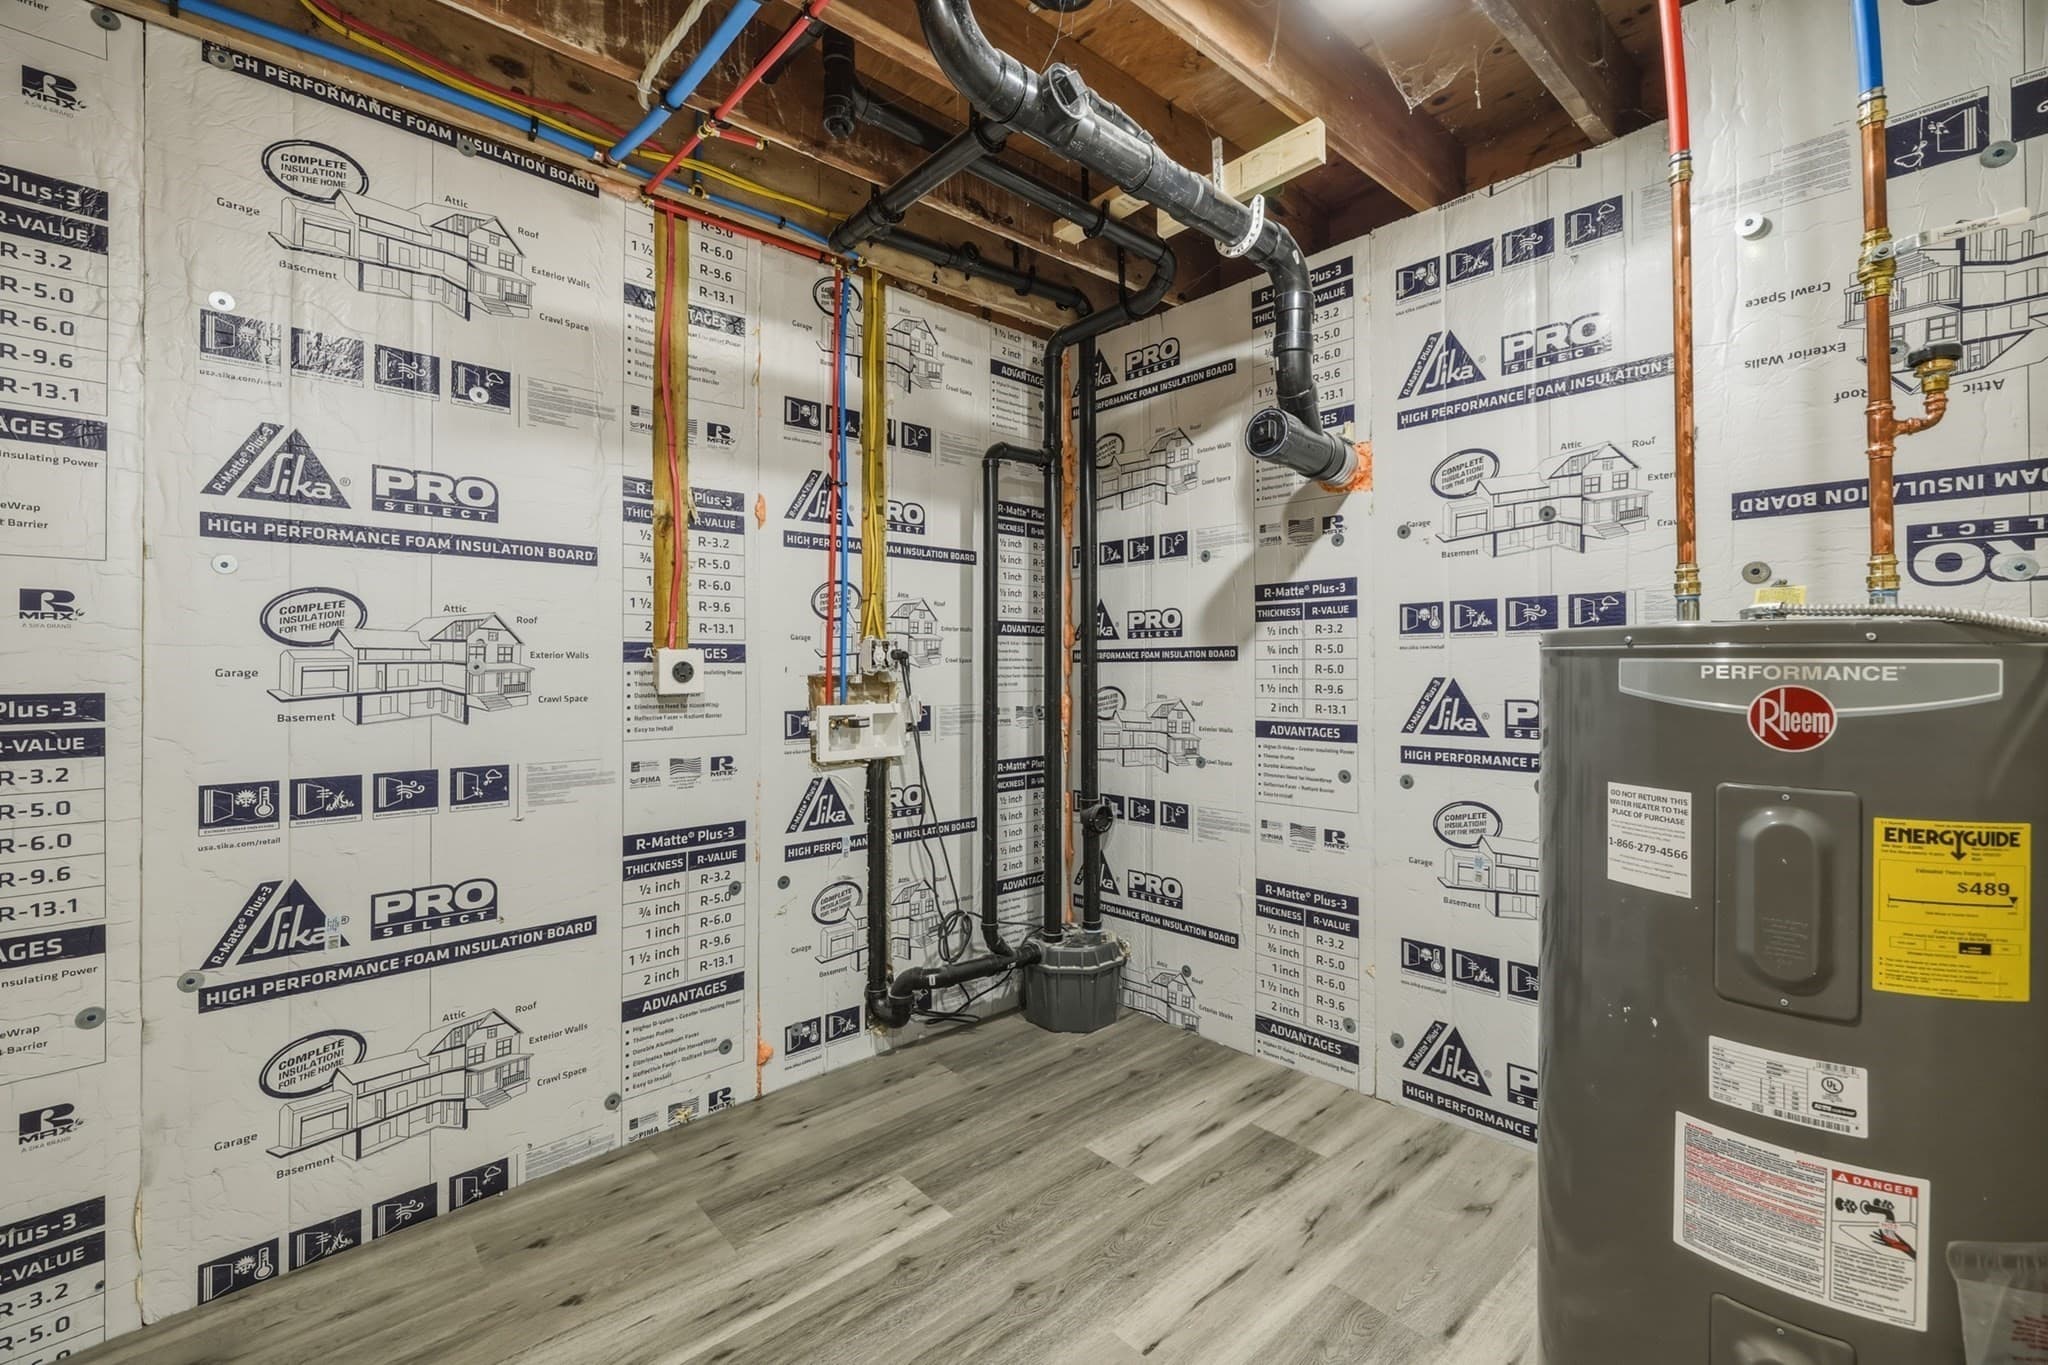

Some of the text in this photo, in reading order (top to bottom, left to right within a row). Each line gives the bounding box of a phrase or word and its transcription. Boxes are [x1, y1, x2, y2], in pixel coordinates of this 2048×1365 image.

[265, 58, 595, 192] PERFORMANCE FOAM BOARD
[280, 153, 347, 171] COMPLETE
[280, 163, 347, 179] INSULATION!
[280, 173, 346, 188] FOR THE HOME
[216, 196, 261, 217] Garage
[444, 194, 469, 209] Attic
[517, 227, 540, 240] Roof
[0, 242, 72, 270] R-3.2
[700, 241, 733, 261] R-6.0
[279, 259, 337, 281] Basement
[531, 265, 591, 290] Exterior Walls
[700, 263, 732, 283] R-9.6
[0, 275, 74, 304] R-5.0
[699, 286, 734, 305] R-13.1
[1745, 281, 1831, 308] Crawl Space
[0, 309, 74, 336] R-6.0
[539, 312, 590, 333] Crawl Space
[1503, 314, 1611, 361] PRO
[0, 342, 73, 368] R-9.6
[1127, 340, 1179, 371] PRO
[1744, 342, 1847, 369] Exterior Walls
[1129, 360, 1178, 380] SELECT
[1160, 363, 1233, 391] INSULATION BOARD
[0, 376, 79, 402] R-13.1
[1962, 378, 2005, 392] Attic
[1401, 381, 1567, 424] HIGH PERFORMANCE FOAM
[246, 426, 275, 455] Plus-3
[1560, 440, 1582, 451] Attic
[62, 457, 98, 469] Power
[255, 453, 333, 501] Sika
[375, 467, 497, 507] PRO
[694, 492, 732, 507] Plus-3
[1740, 491, 1817, 513] BOARD
[384, 502, 490, 521] SELECT
[7, 518, 48, 529] Barrier
[694, 517, 736, 530] R-VALUE
[207, 518, 593, 562] HIGH PERFORMANCE FOAM INSULATION BOARD
[698, 536, 730, 549] R-3.2
[786, 534, 975, 561] HIGH INSULATION BOARD
[698, 558, 730, 570] R-5.0
[1312, 583, 1346, 595] Plus-3
[279, 600, 346, 616] COMPLETE
[443, 603, 467, 613] Attic
[1257, 605, 1349, 618] THICKNESS R-VALUE
[279, 610, 345, 625] INSULATION!
[319, 619, 345, 630] HOME
[516, 615, 538, 624] Roof
[1130, 610, 1181, 630] PRO
[699, 622, 734, 634] R-13.1
[1279, 624, 1343, 635] inch R-3.2
[790, 633, 811, 642] Garage
[530, 651, 590, 660] Exterior Walls
[1315, 644, 1344, 654] R-5.0
[215, 668, 259, 680] Garage
[1315, 664, 1344, 674] R-6.0
[538, 695, 589, 704] Crawl Space
[277, 712, 336, 723] Basement
[1279, 704, 1346, 714] inch R-13.1
[1428, 698, 1478, 732] Sika
[1759, 688, 1830, 740] Rheem
[1270, 725, 1341, 739] ADVANTAGES
[1404, 750, 1528, 768] HIGH PERFORMANCE
[0, 768, 69, 786] R-3.2
[640, 775, 661, 785] PIMA
[809, 781, 847, 826] Sika
[1610, 798, 1632, 807] WATER
[1633, 802, 1659, 811] HEATER
[1674, 808, 1688, 816] THE
[1638, 793, 1668, 804] RETURN
[1671, 797, 1688, 806] THIS
[0, 800, 71, 820] R-5.0
[1444, 812, 1487, 822] COMPLETE
[1612, 808, 1632, 817] PLACE
[1644, 814, 1685, 825] PURCHASE
[697, 827, 735, 842] Plus-3
[197, 836, 281, 852] usa.sika.com/retail
[1609, 837, 1688, 860] 1-866-279-4566
[697, 849, 738, 864] R-VALUE
[1409, 857, 1433, 867] Garage
[626, 857, 684, 875] THICKNESS
[700, 870, 731, 884] R-3.2
[1957, 882, 2010, 896] $489
[0, 899, 77, 922] R-13.1
[244, 886, 273, 918] Plus-3
[374, 881, 496, 925] PRO
[382, 911, 489, 937] SELECT
[700, 912, 732, 927] R-6.0
[1313, 916, 1351, 931] R-VALUE
[252, 904, 330, 954] Sika
[655, 924, 680, 938] inch
[1208, 930, 1236, 945] BOARD
[700, 934, 731, 950] R-9.6
[206, 921, 593, 1006] HIGH PERFORMANCE FOAM INSULATION BOARD
[700, 955, 734, 972] R-13.1
[644, 968, 680, 986] 2 inch
[1316, 976, 1345, 991] R-6.0
[642, 980, 728, 1013] ADVANTAGES
[442, 1009, 466, 1022] Attic
[515, 1001, 537, 1014] Roof
[1270, 1024, 1342, 1055] ADVANTAGES
[278, 1039, 345, 1070] COMPLETE
[278, 1048, 345, 1081] INSULATION!
[1431, 1044, 1480, 1087] Sika
[1406, 1085, 1530, 1137] HIGH PERFORMANCE
[214, 1132, 259, 1152] Garage
[276, 1154, 335, 1180] Basement
[1853, 1177, 1914, 1196] DANGER
